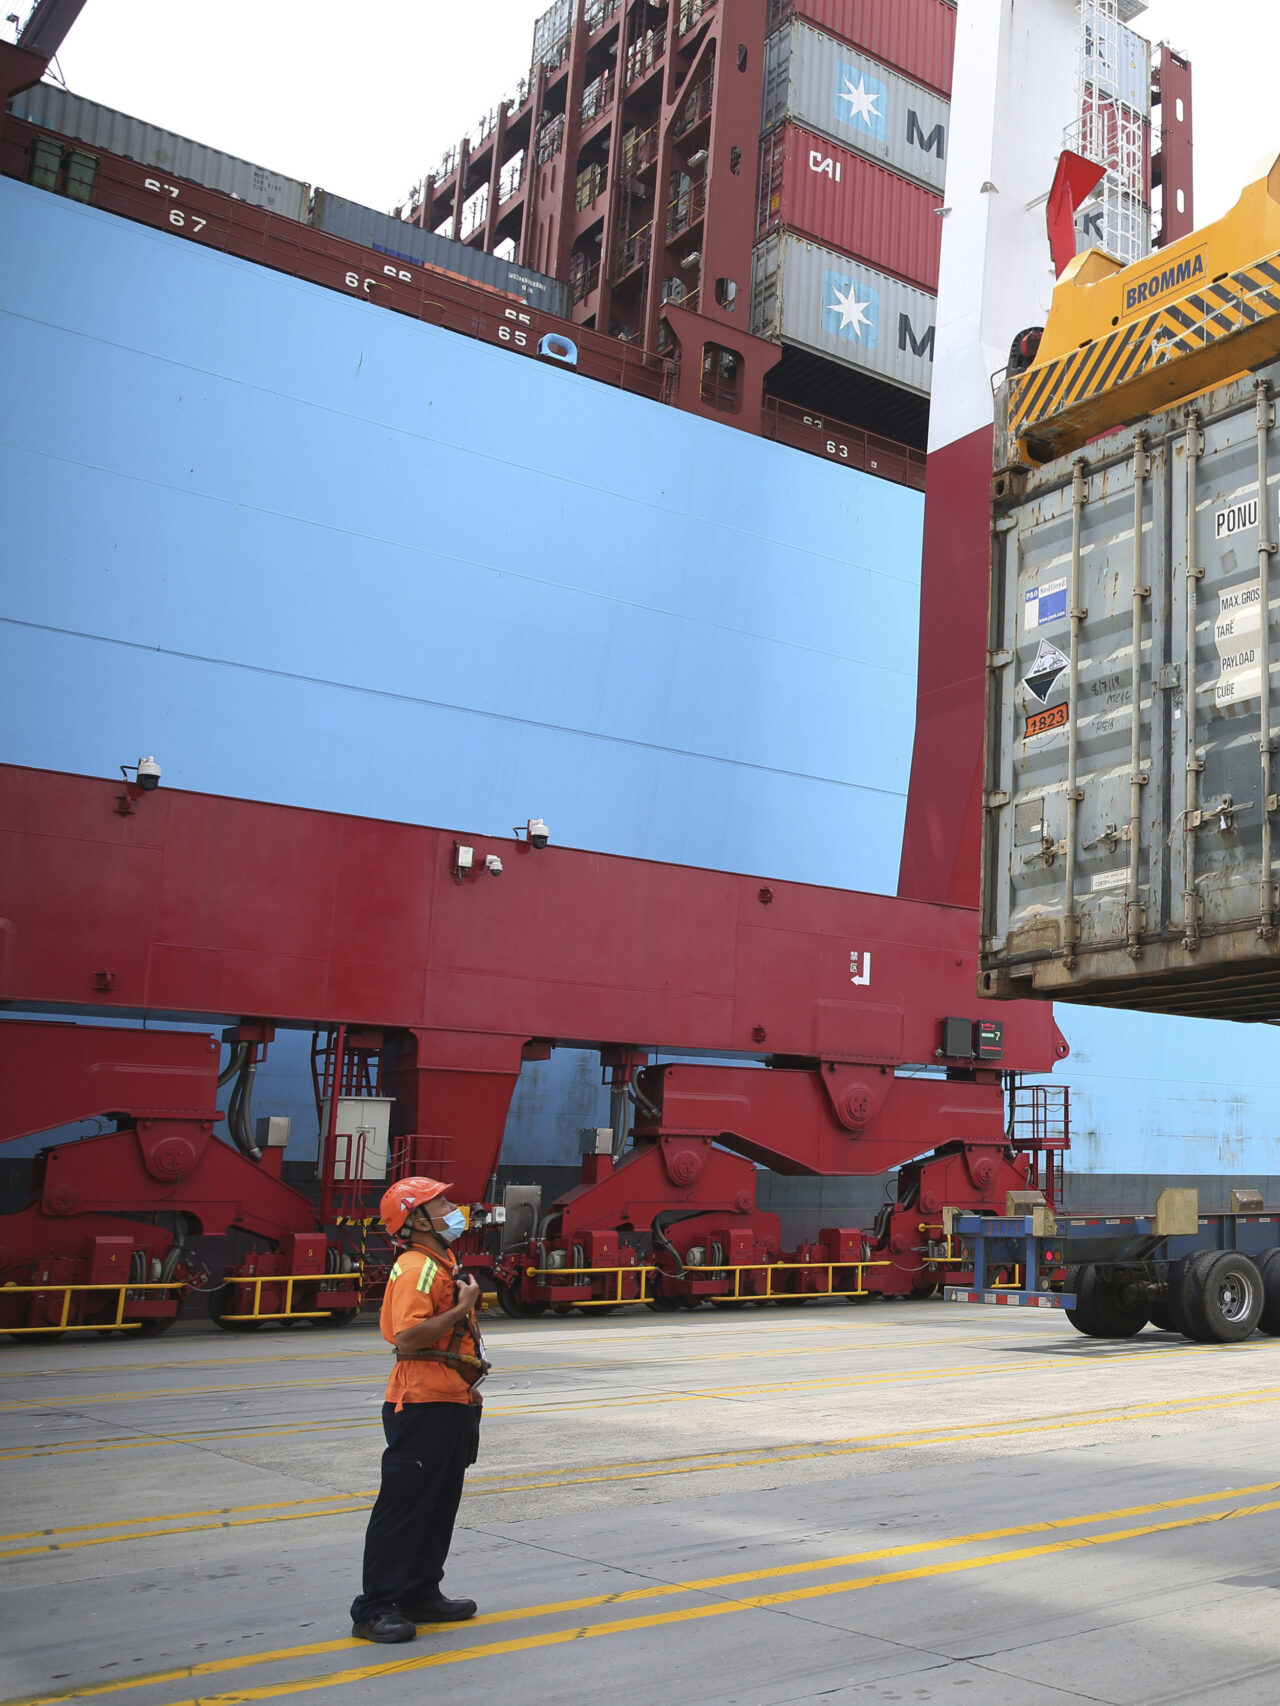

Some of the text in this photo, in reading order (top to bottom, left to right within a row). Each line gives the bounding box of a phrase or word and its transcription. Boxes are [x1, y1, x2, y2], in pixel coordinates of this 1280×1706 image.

[809, 150, 841, 182] CAI
[169, 209, 207, 232] 67
[1126, 254, 1204, 310] BROMMA
[498, 326, 527, 346] 65
[826, 440, 848, 457] 63
[1216, 501, 1257, 537] PONU
[1217, 622, 1235, 638] TARE
[1222, 650, 1255, 671] PAYLOAD
[1216, 683, 1235, 699] CUBE
[1030, 709, 1065, 733] 1823
